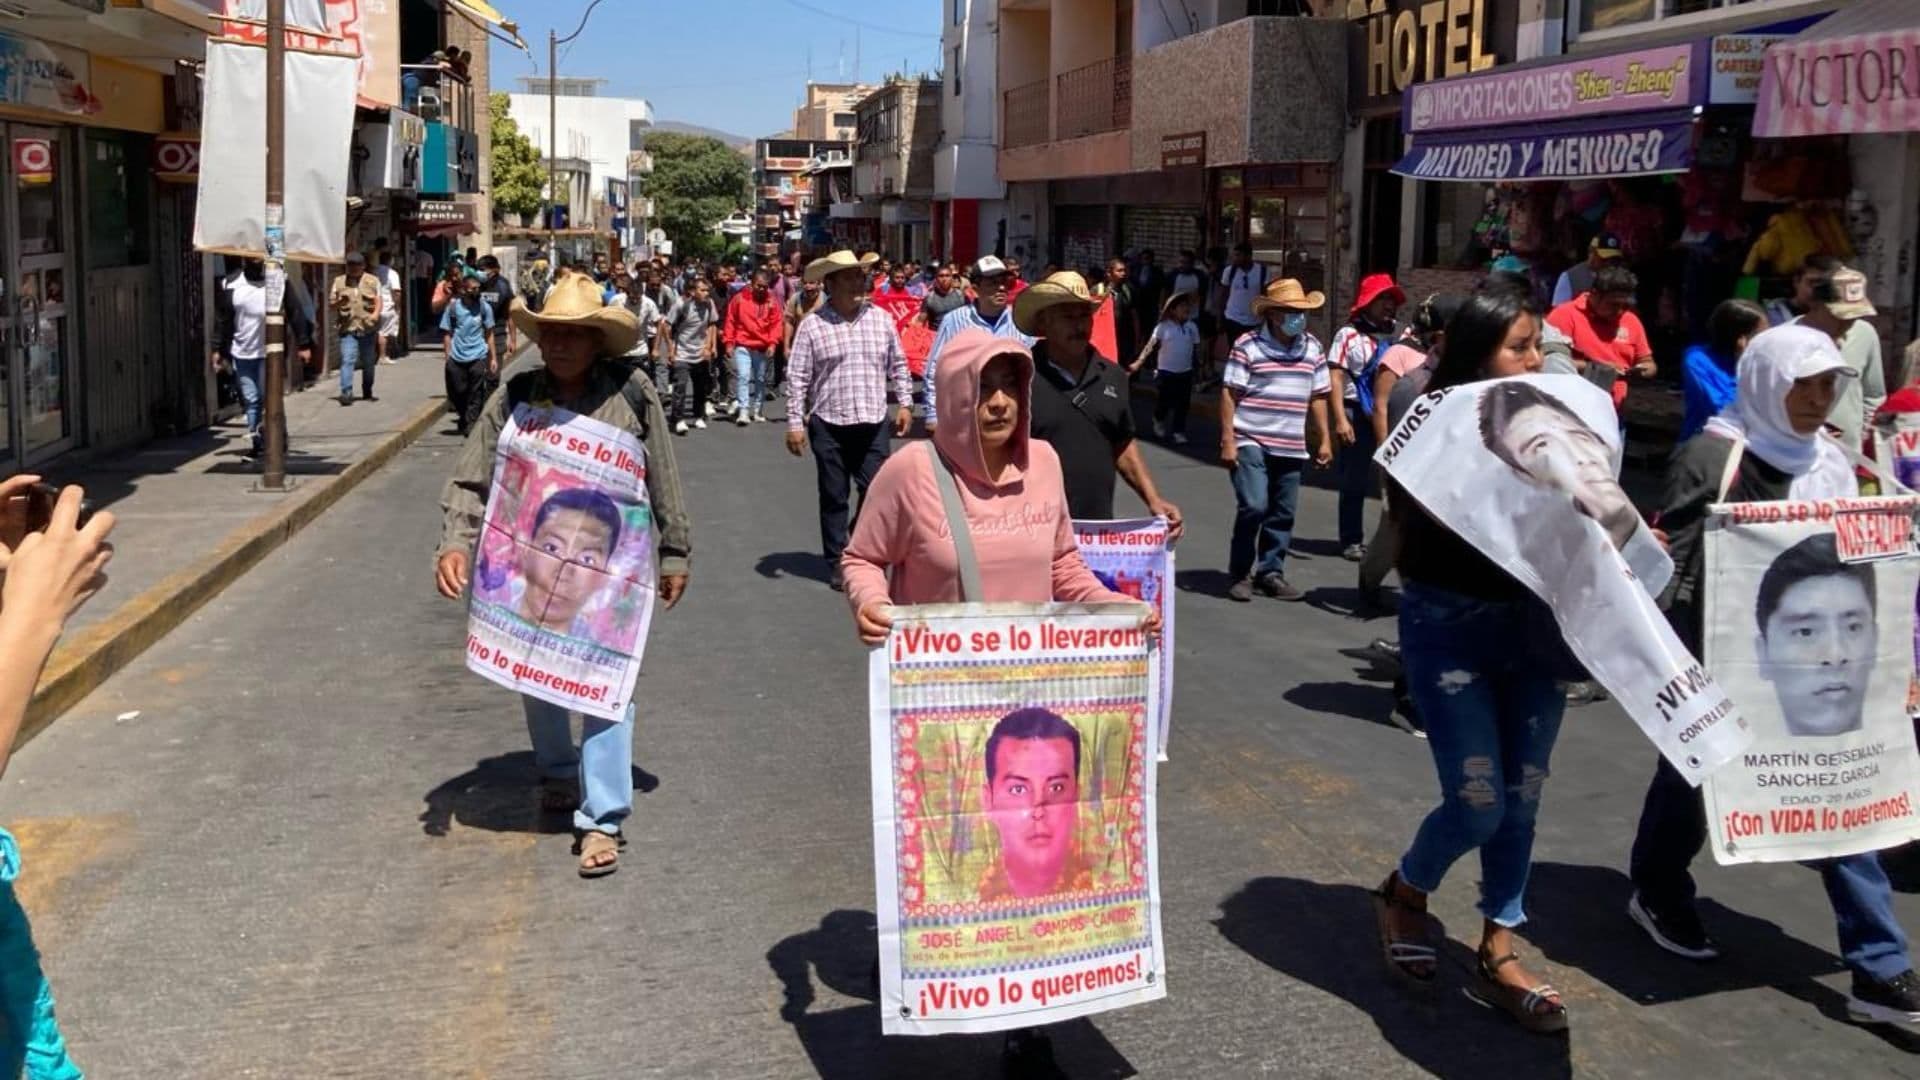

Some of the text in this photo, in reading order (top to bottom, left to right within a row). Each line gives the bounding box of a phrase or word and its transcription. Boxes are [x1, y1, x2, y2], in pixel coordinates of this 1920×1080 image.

[1367, 0, 1496, 96] HOTEL
[1434, 71, 1573, 123] IMPORTACIONES
[1519, 142, 1535, 176] Y
[1541, 129, 1664, 176] MENUDEO
[566, 436, 590, 456] se
[594, 442, 612, 463] lo
[1079, 529, 1094, 546] lo
[895, 626, 962, 661] ¡Vivo
[971, 629, 1000, 652] se
[1010, 624, 1031, 650] lo
[492, 649, 509, 669] lo
[511, 661, 609, 702] queremos!
[1744, 749, 1809, 767] MARTÍN
[1725, 791, 1914, 846] ¡Con VIDA lo queremos!
[1780, 795, 1822, 806] EDAD
[920, 929, 963, 949] JOSÉ
[919, 954, 1142, 1016] ¡Vivo lo queremos!
